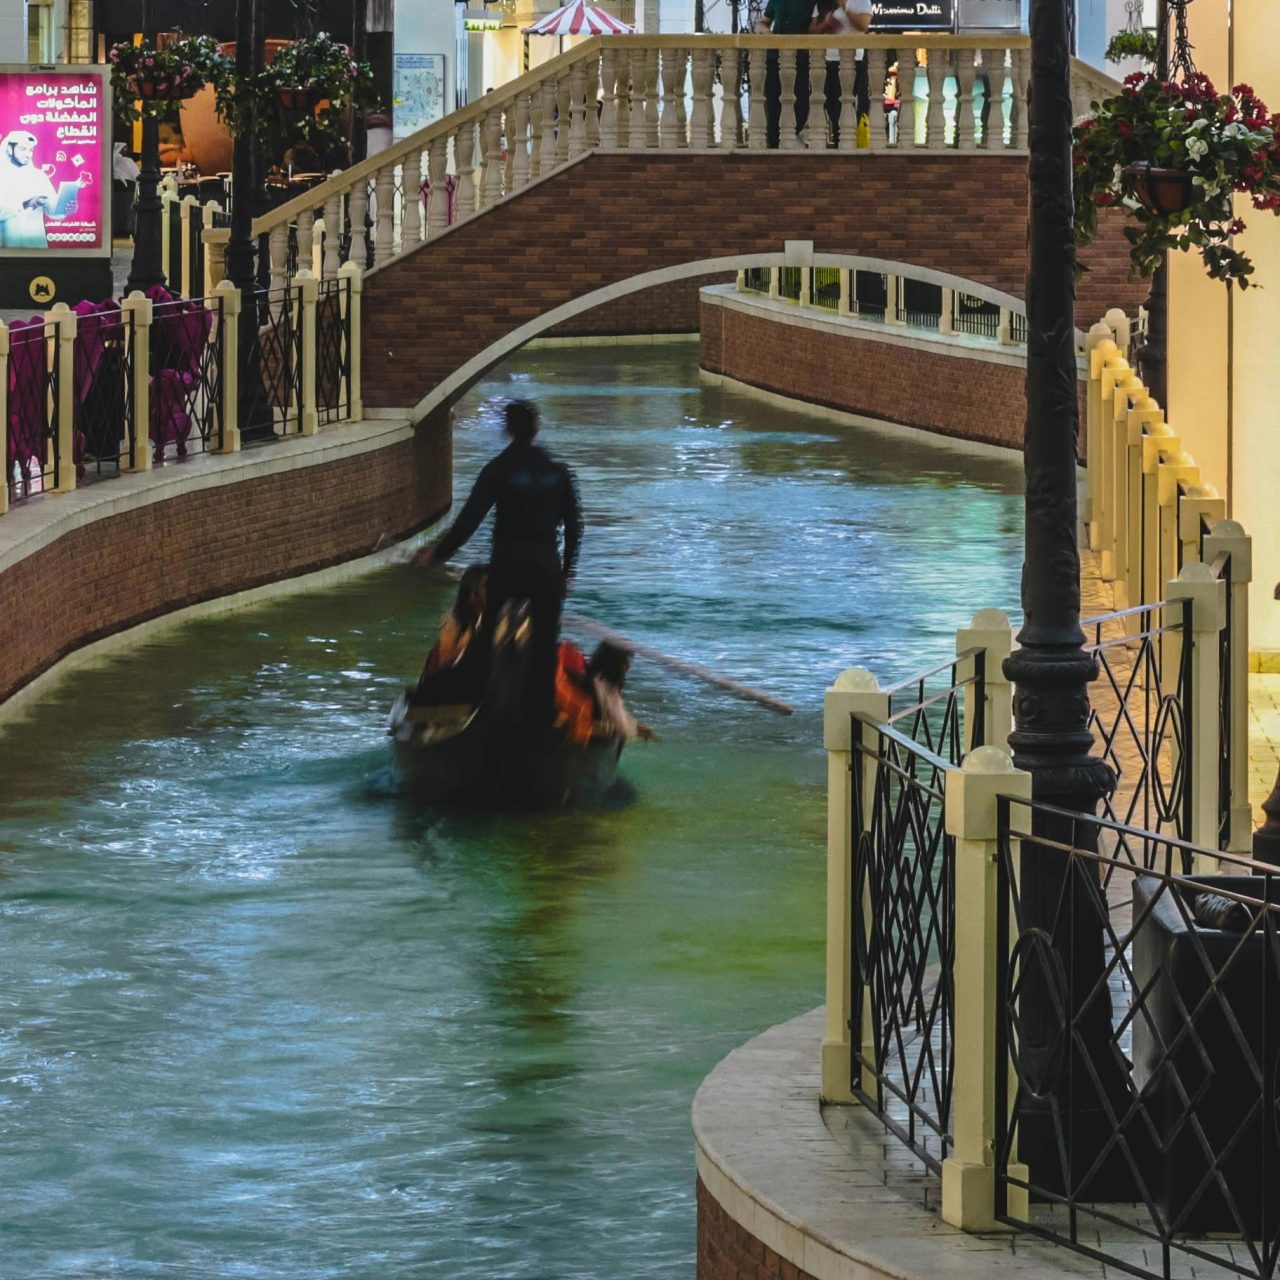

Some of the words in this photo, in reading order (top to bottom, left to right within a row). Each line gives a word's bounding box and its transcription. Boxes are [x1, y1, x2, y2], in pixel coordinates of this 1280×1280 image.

[916, 2, 943, 15] Dutti
[60, 81, 97, 94] شاهد
[36, 95, 97, 110] المأكولات
[56, 125, 97, 138] انقطاع
